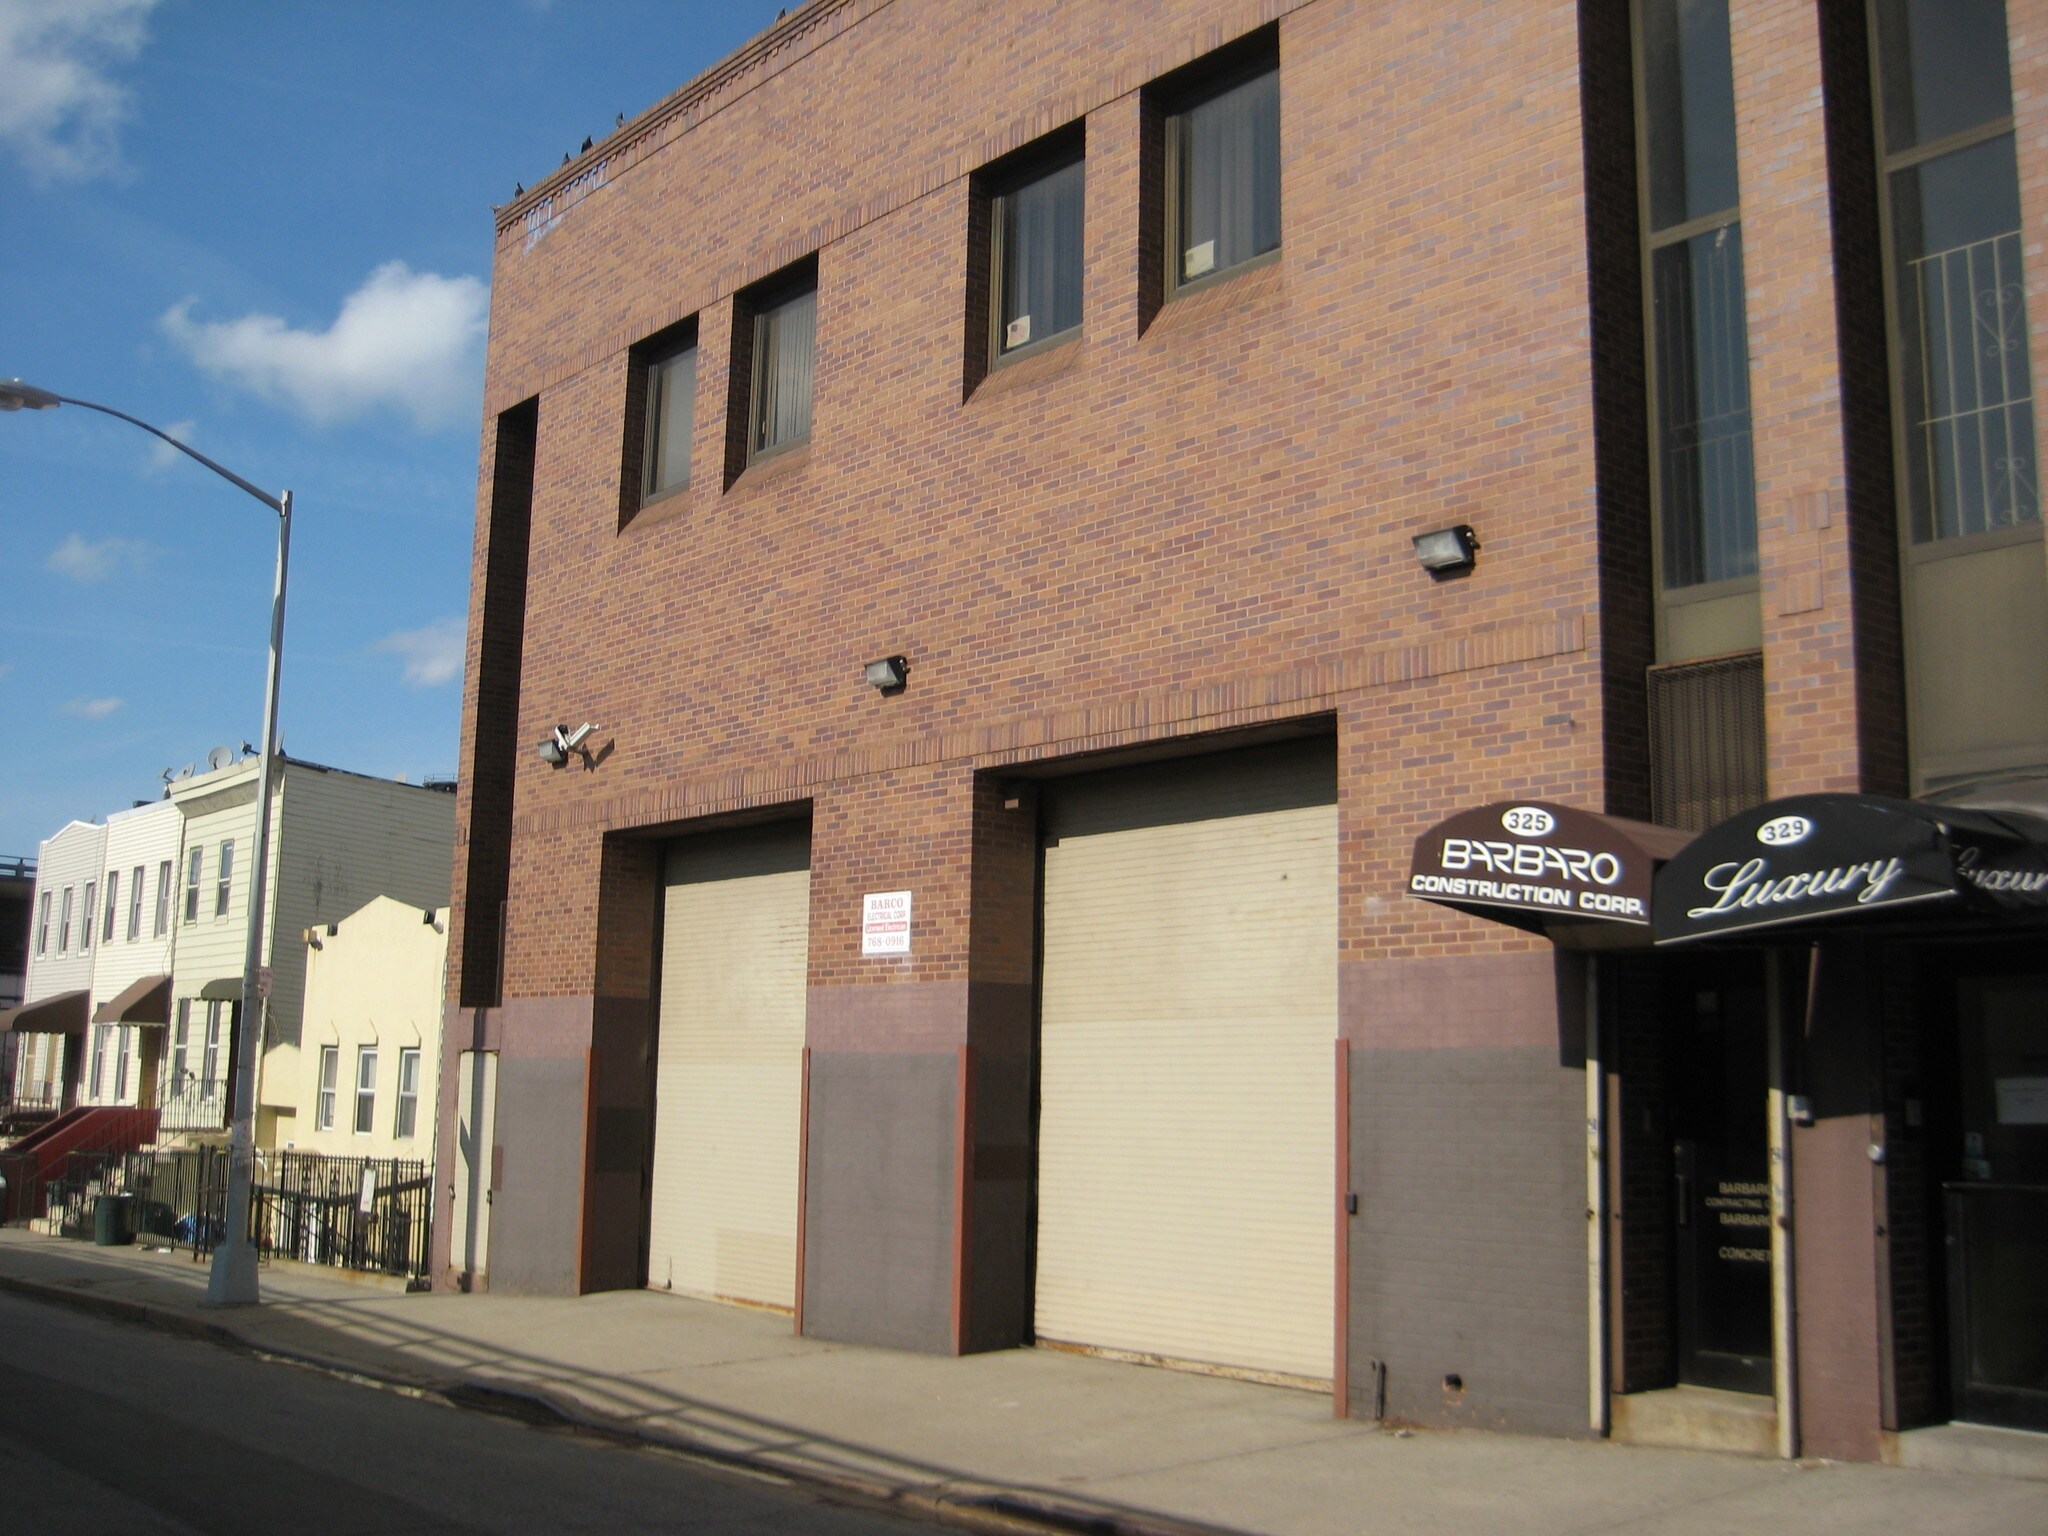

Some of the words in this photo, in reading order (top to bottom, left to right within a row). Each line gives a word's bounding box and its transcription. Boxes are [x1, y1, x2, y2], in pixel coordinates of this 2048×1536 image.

[1508, 811, 1547, 832] 325
[1763, 819, 1804, 842] 329
[1441, 838, 1622, 885] BARBARO
[871, 898, 904, 910] BARCO
[1410, 874, 1572, 907] CONSTRUCTION
[1579, 891, 1645, 916] CORP.
[1686, 857, 1903, 919] Luxury
